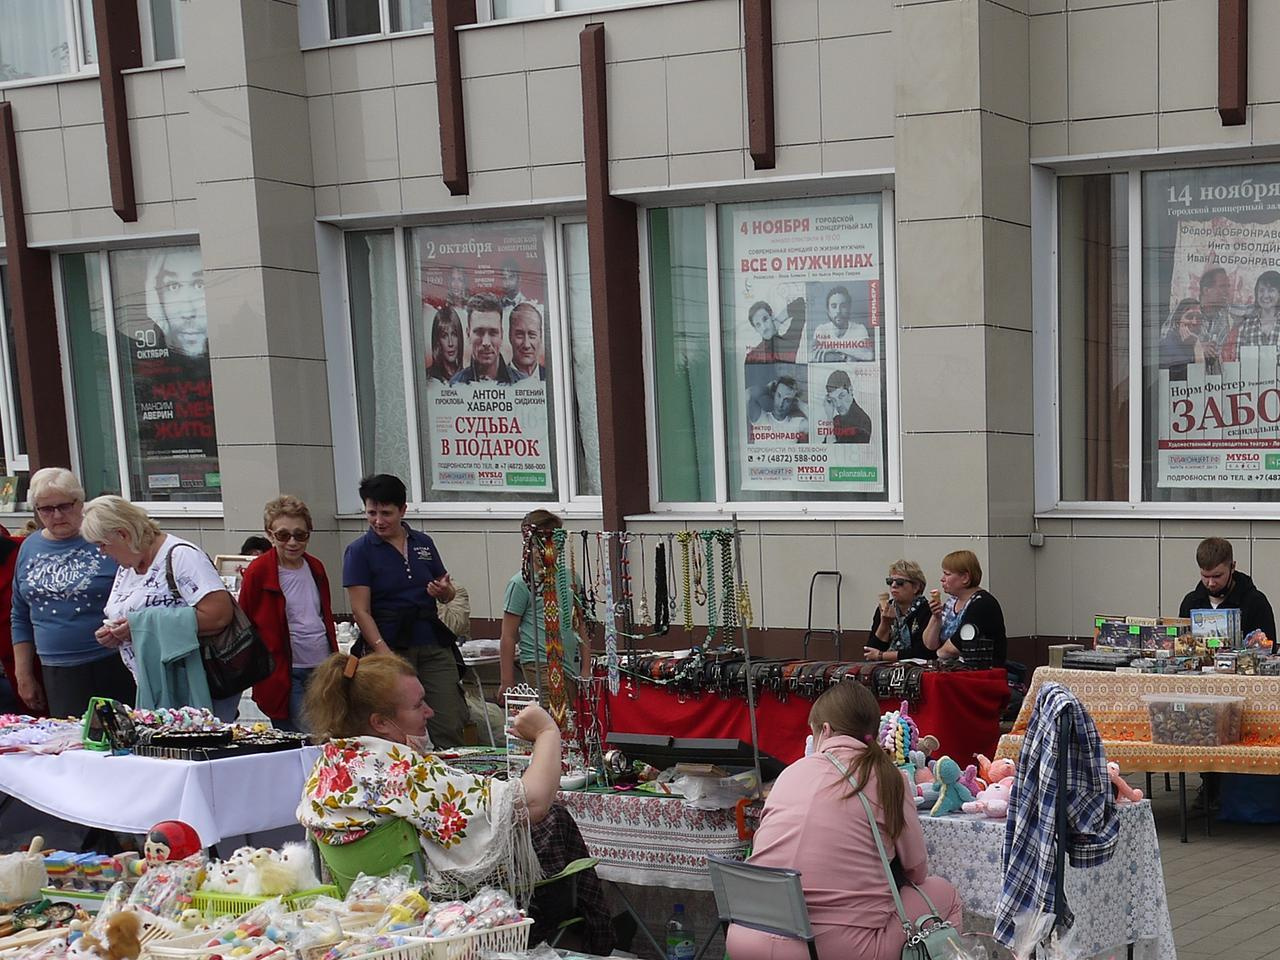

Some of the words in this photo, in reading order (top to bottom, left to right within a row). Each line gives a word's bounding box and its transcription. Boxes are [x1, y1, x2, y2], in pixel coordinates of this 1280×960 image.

[1167, 184, 1193, 206] 14
[1200, 178, 1280, 202] ноября
[1167, 206, 1210, 217] Городской
[1212, 203, 1265, 214] концертный
[1266, 203, 1280, 211] зал
[815, 215, 854, 224] ГОРОДСКОЙ
[740, 221, 749, 236] 4
[752, 218, 810, 235] НОЯБРЯ
[815, 223, 859, 231] КОНЦЕРТНЫЙ
[860, 222, 873, 230] ЗАЛ
[427, 241, 436, 259] 2
[440, 238, 493, 257] октября
[1208, 240, 1231, 251] Инга
[741, 258, 768, 273] ВСЕ
[771, 257, 783, 271] О
[786, 253, 874, 271] МУЖЧИНАХ
[1187, 254, 1210, 264] Иван
[135, 329, 156, 347] 30
[137, 348, 170, 359] ОКТЯБРЯ
[472, 389, 506, 400] АНТОН
[515, 388, 544, 397] ЕВГЕНИЙ
[1171, 386, 1203, 399] Норм
[1204, 380, 1246, 395] Фостер
[467, 402, 513, 412] ХАБАРОВ
[143, 411, 174, 420] АВЕРИН
[455, 416, 522, 438] СУДЬБА
[441, 439, 450, 456] В
[455, 438, 540, 460] ПОДАРОК
[768, 454, 792, 463] (4872)
[794, 454, 828, 463] 588-000
[1226, 453, 1260, 461] MYSLO
[838, 469, 876, 478] planzala.ru
[1167, 474, 1216, 482] ПОДРОБНОСТИ
